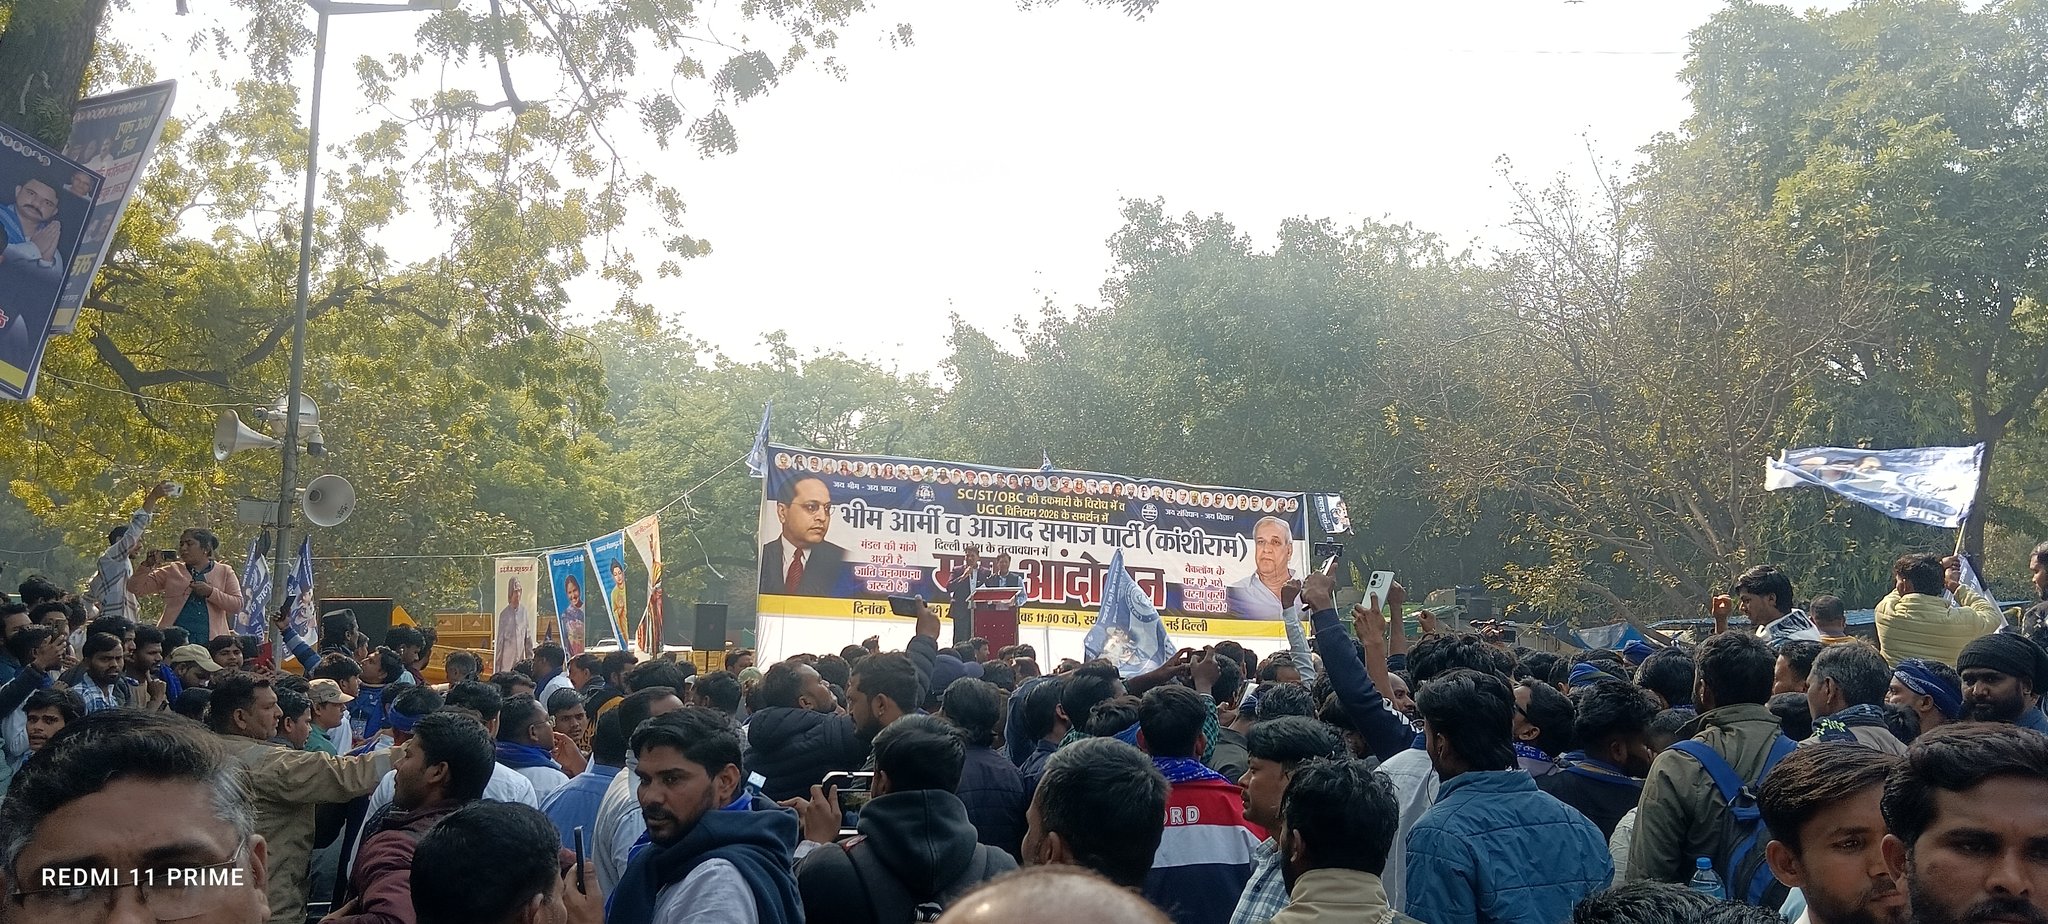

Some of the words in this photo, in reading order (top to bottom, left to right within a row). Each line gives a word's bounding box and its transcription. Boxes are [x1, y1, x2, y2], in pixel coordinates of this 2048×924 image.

[833, 481, 845, 489] जय
[847, 481, 860, 490] भीम
[880, 485, 896, 493] भारत
[957, 488, 1024, 504] SC/ST/OBC
[1027, 494, 1038, 505] की
[1041, 495, 1072, 507] हकमारी
[1073, 496, 1082, 507] के
[1084, 498, 1108, 510] विरोध
[1110, 500, 1118, 511] में
[1118, 502, 1125, 512] व
[976, 503, 1002, 516] UGC
[1004, 504, 1036, 518] विनियम
[1038, 509, 1059, 520] 2026
[1061, 510, 1070, 520] के
[1072, 511, 1100, 523] समर्थन
[1101, 512, 1110, 524] में
[1176, 510, 1200, 518] संविधान
[840, 501, 884, 530] भीम
[890, 507, 942, 535] आर्मी
[945, 516, 962, 536] व
[968, 517, 1034, 542] आजाद
[1038, 522, 1098, 546] समाज
[1102, 522, 1142, 549] पार्टी
[1146, 526, 1248, 562] (कांशीराम)
[861, 539, 880, 550] मंडल
[884, 540, 896, 551] की
[934, 538, 960, 552] दिल्ली
[986, 541, 996, 554] के
[1041, 545, 1050, 558] में
[870, 553, 894, 566] अधूरी
[856, 565, 876, 576] जाति
[880, 568, 921, 579] जनगणना
[1018, 549, 1165, 606] आंदोन
[1216, 566, 1225, 576] के
[868, 580, 894, 591] जरूरी
[1183, 577, 1194, 585] पद
[1198, 576, 1208, 588] पूरे
[854, 600, 886, 615] दिनांक
[1184, 600, 1204, 611] खाली
[1036, 612, 1060, 624] 11:00
[1062, 612, 1082, 627] बजे,
[1166, 620, 1180, 632] नई
[1181, 620, 1208, 632] दिल्ली
[1164, 806, 1200, 825] RD
